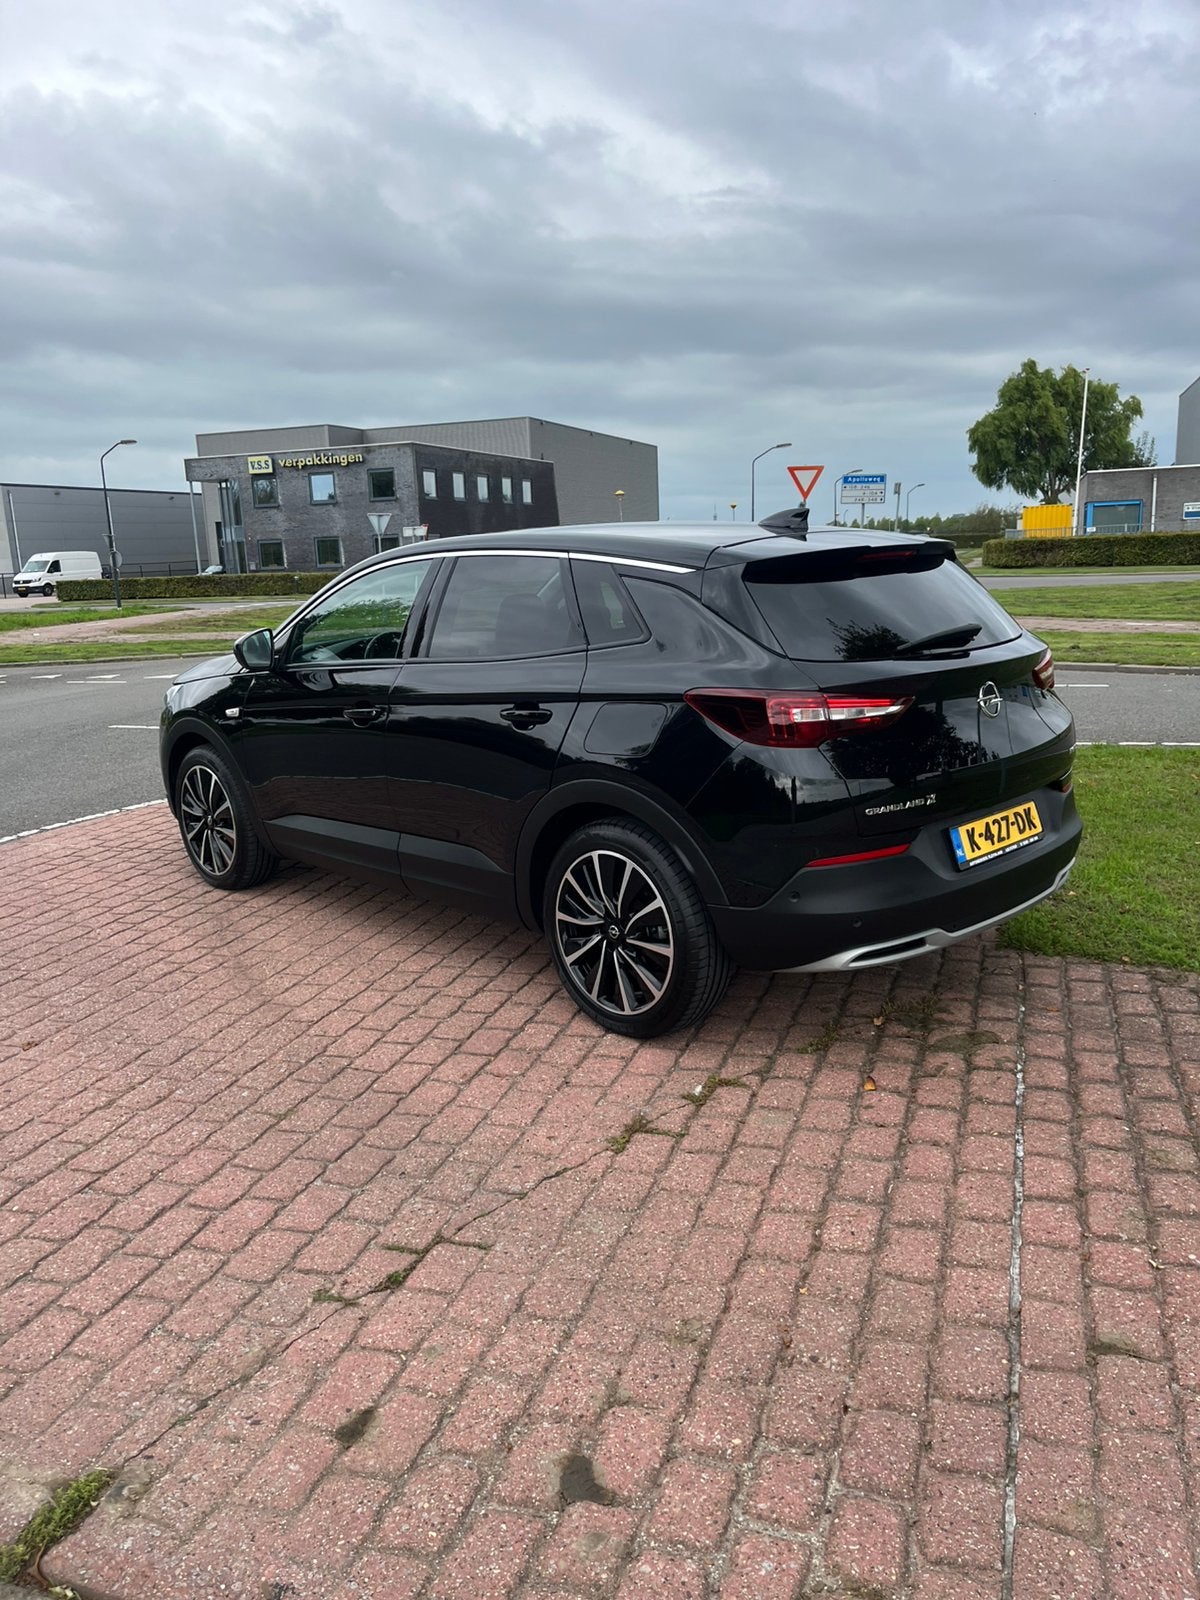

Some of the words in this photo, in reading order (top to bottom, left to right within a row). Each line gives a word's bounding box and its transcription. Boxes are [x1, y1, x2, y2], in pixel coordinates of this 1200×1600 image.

[279, 452, 363, 469] verpakkingen
[865, 798, 925, 815] GRANDLAND
[925, 793, 937, 806] X
[966, 806, 1037, 853] K-427-DK
[956, 849, 965, 858] NL
